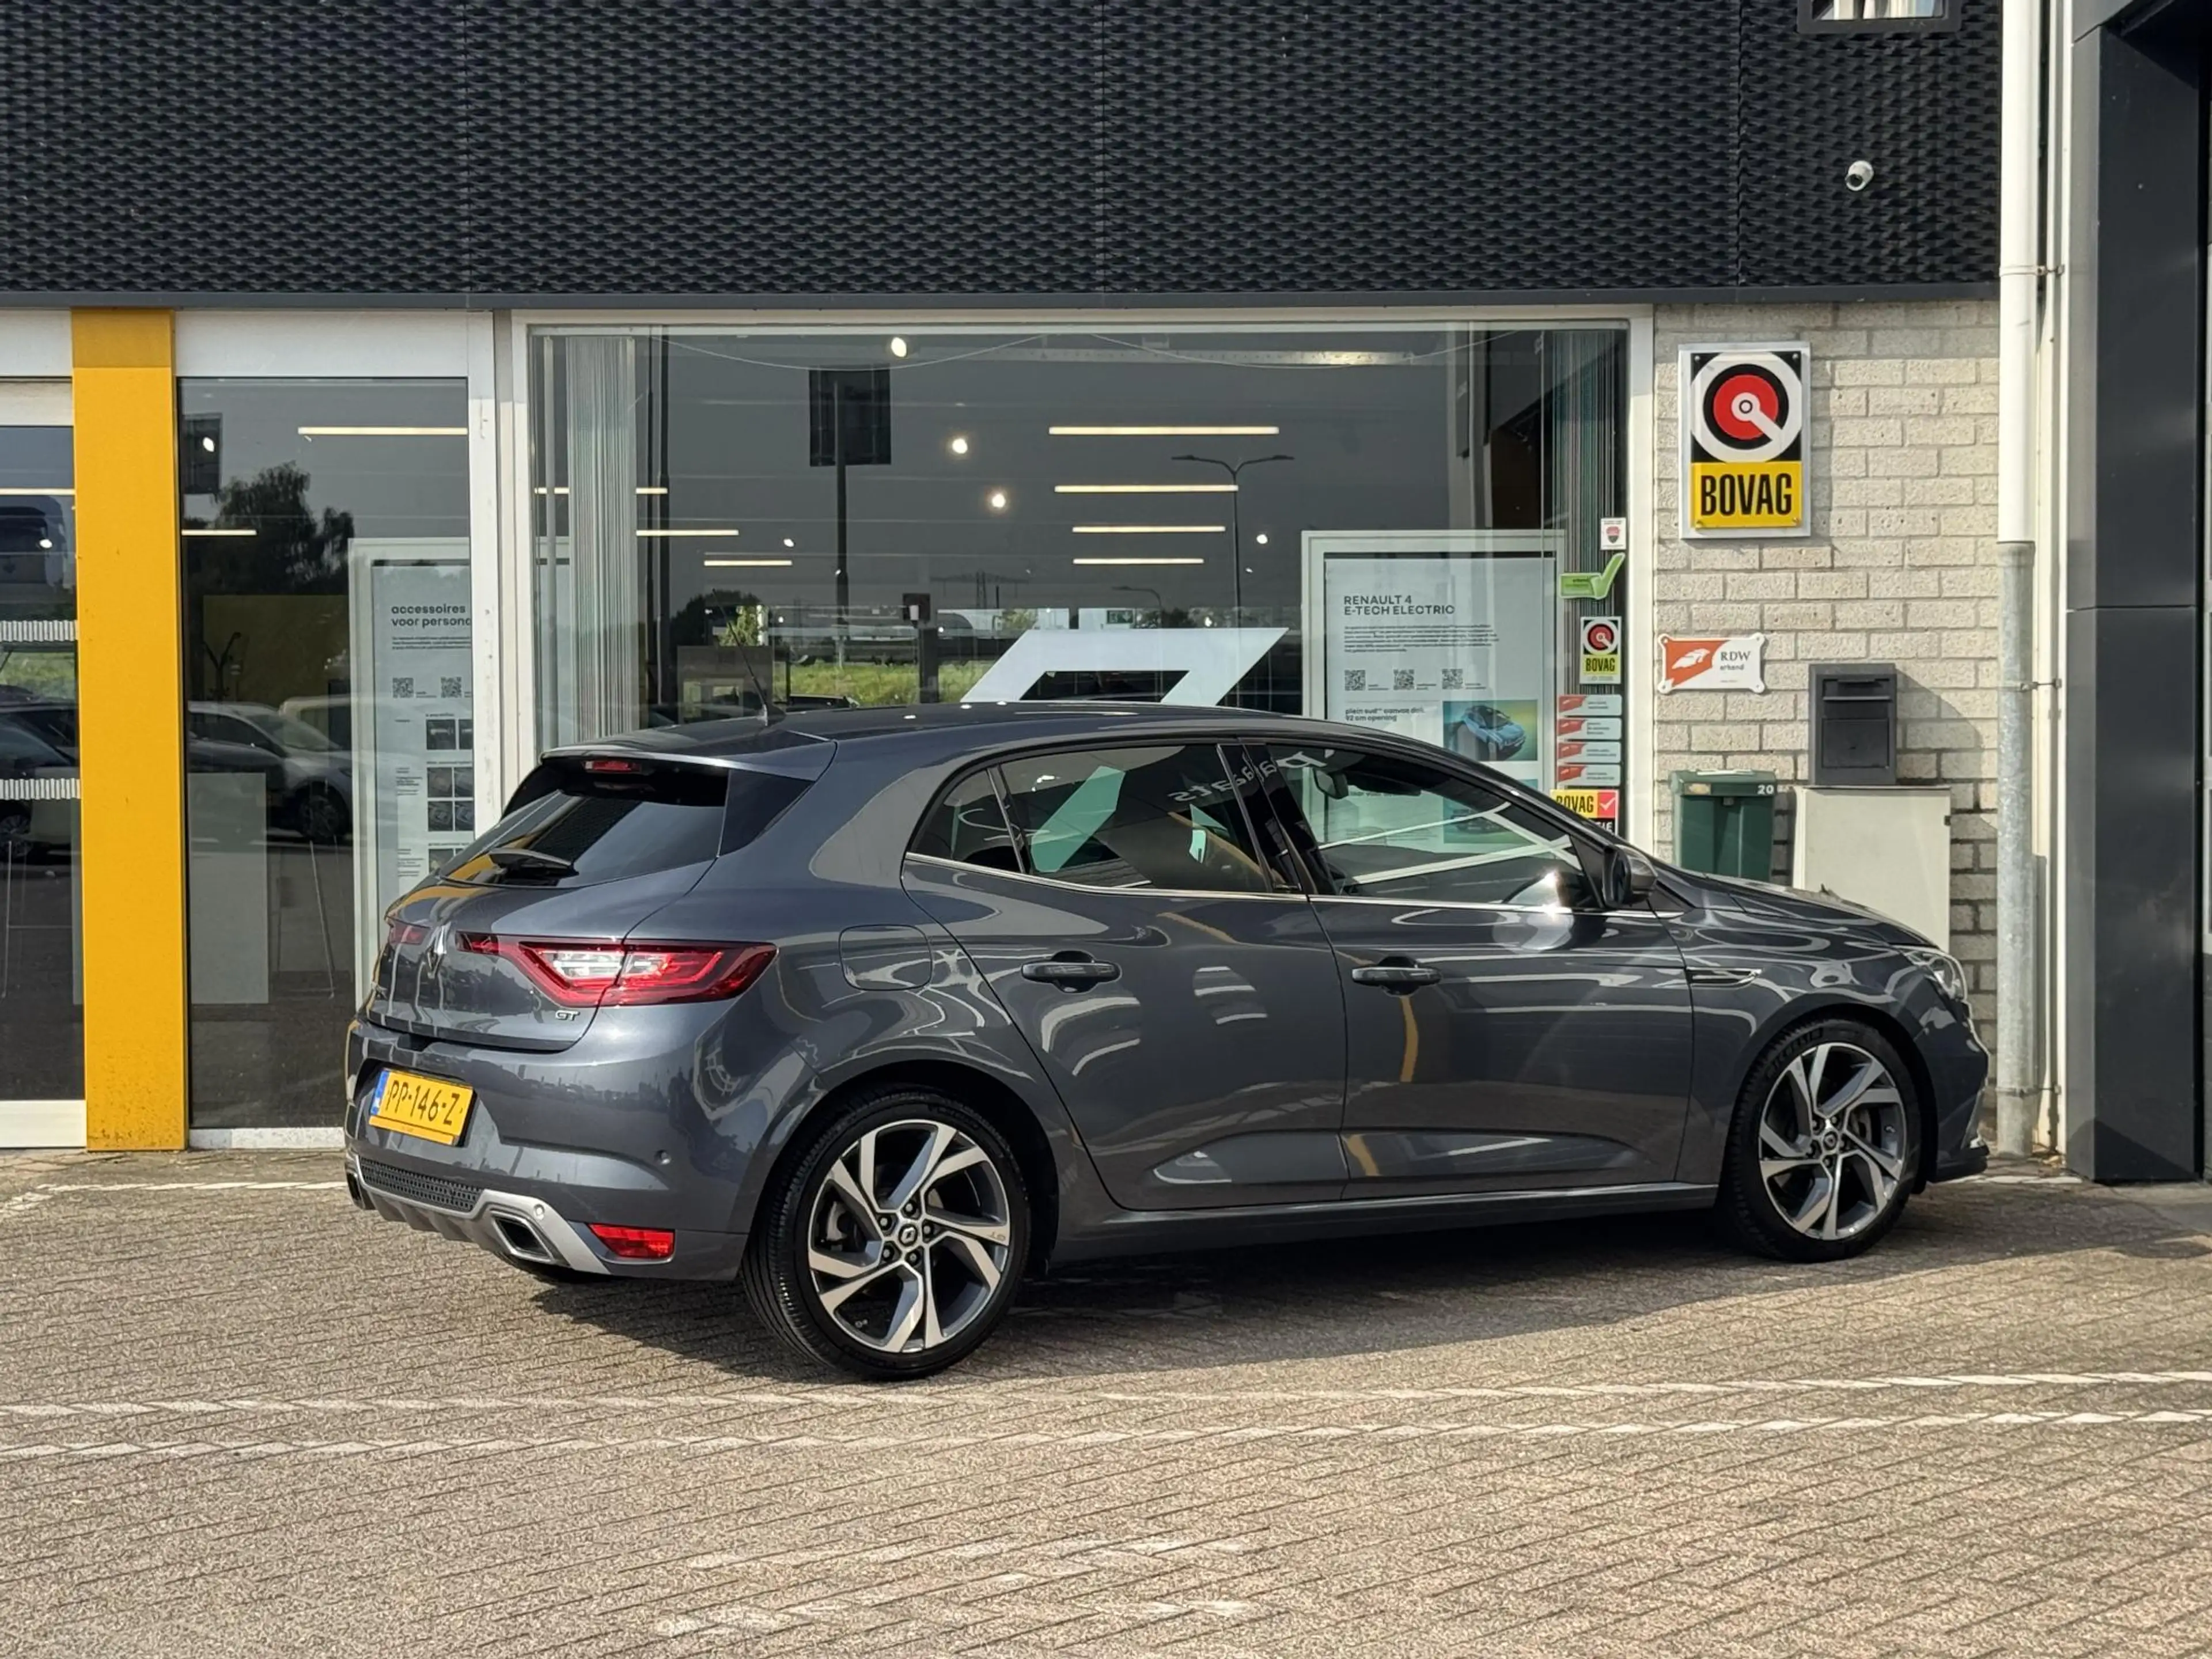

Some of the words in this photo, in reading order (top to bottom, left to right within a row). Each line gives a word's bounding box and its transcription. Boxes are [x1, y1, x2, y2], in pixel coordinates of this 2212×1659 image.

[1701, 473, 1792, 516] BOVAG
[1344, 595, 1402, 605] RENAULT
[1404, 595, 1412, 604] 4
[391, 603, 465, 614] accessoires
[1344, 606, 1389, 615] E-TECH
[1393, 605, 1455, 615] ELECTRIC
[391, 618, 419, 626] voor
[1720, 650, 1751, 661] RDW
[1585, 658, 1616, 672] BOVAG
[1757, 785, 1775, 795] 20
[555, 1010, 581, 1021] GT
[385, 1080, 460, 1126] PP-146-Z
